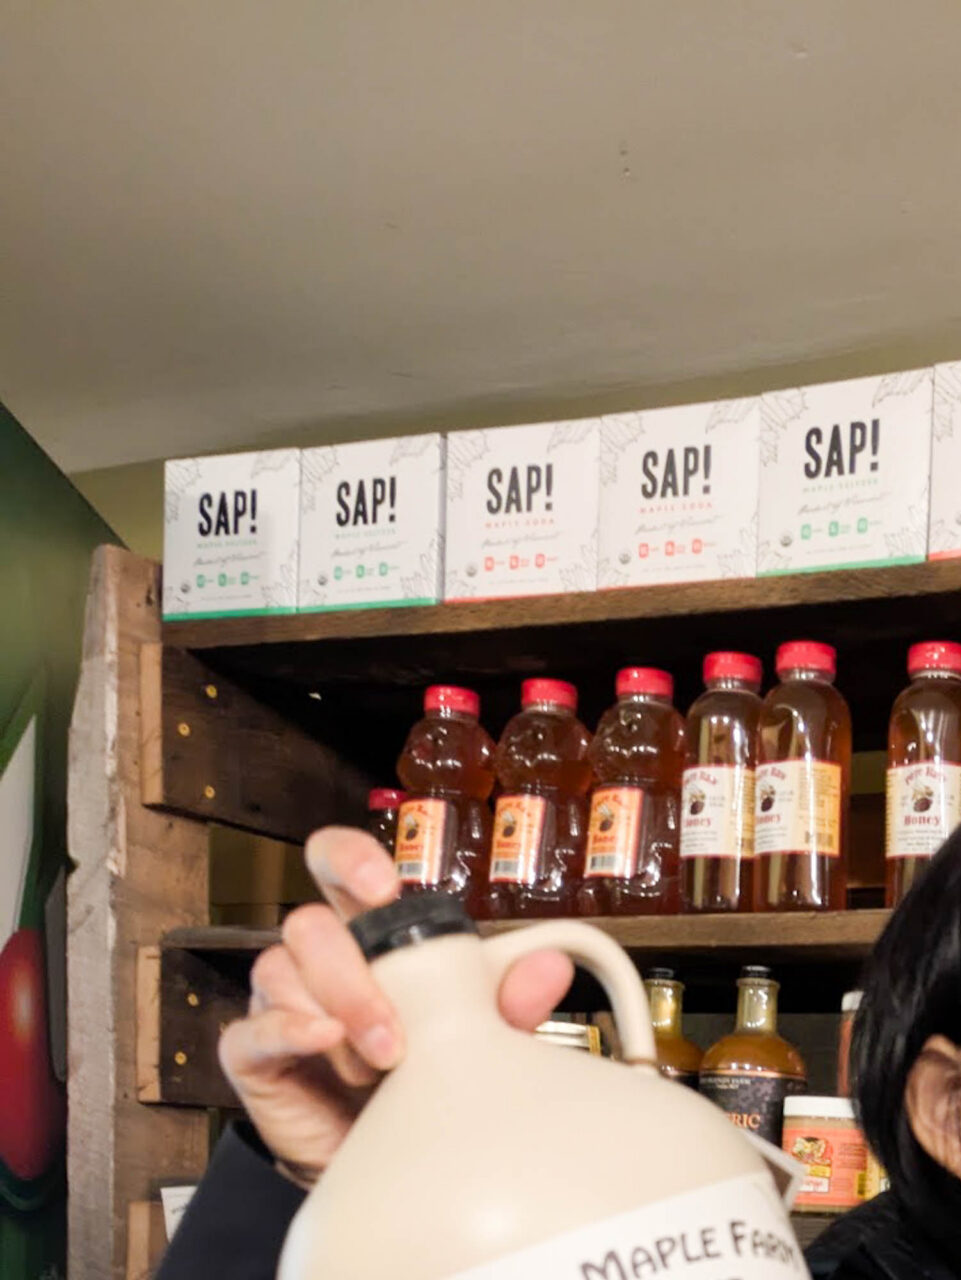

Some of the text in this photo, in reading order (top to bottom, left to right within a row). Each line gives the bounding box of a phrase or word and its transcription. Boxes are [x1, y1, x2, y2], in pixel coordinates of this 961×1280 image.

[641, 444, 712, 500] SAP!
[804, 418, 880, 480] SAP!
[198, 489, 258, 537] SAP!
[335, 476, 397, 527] SAP!
[486, 463, 554, 515] SAP!
[904, 815, 941, 827] Honey
[729, 1111, 761, 1130] RIC
